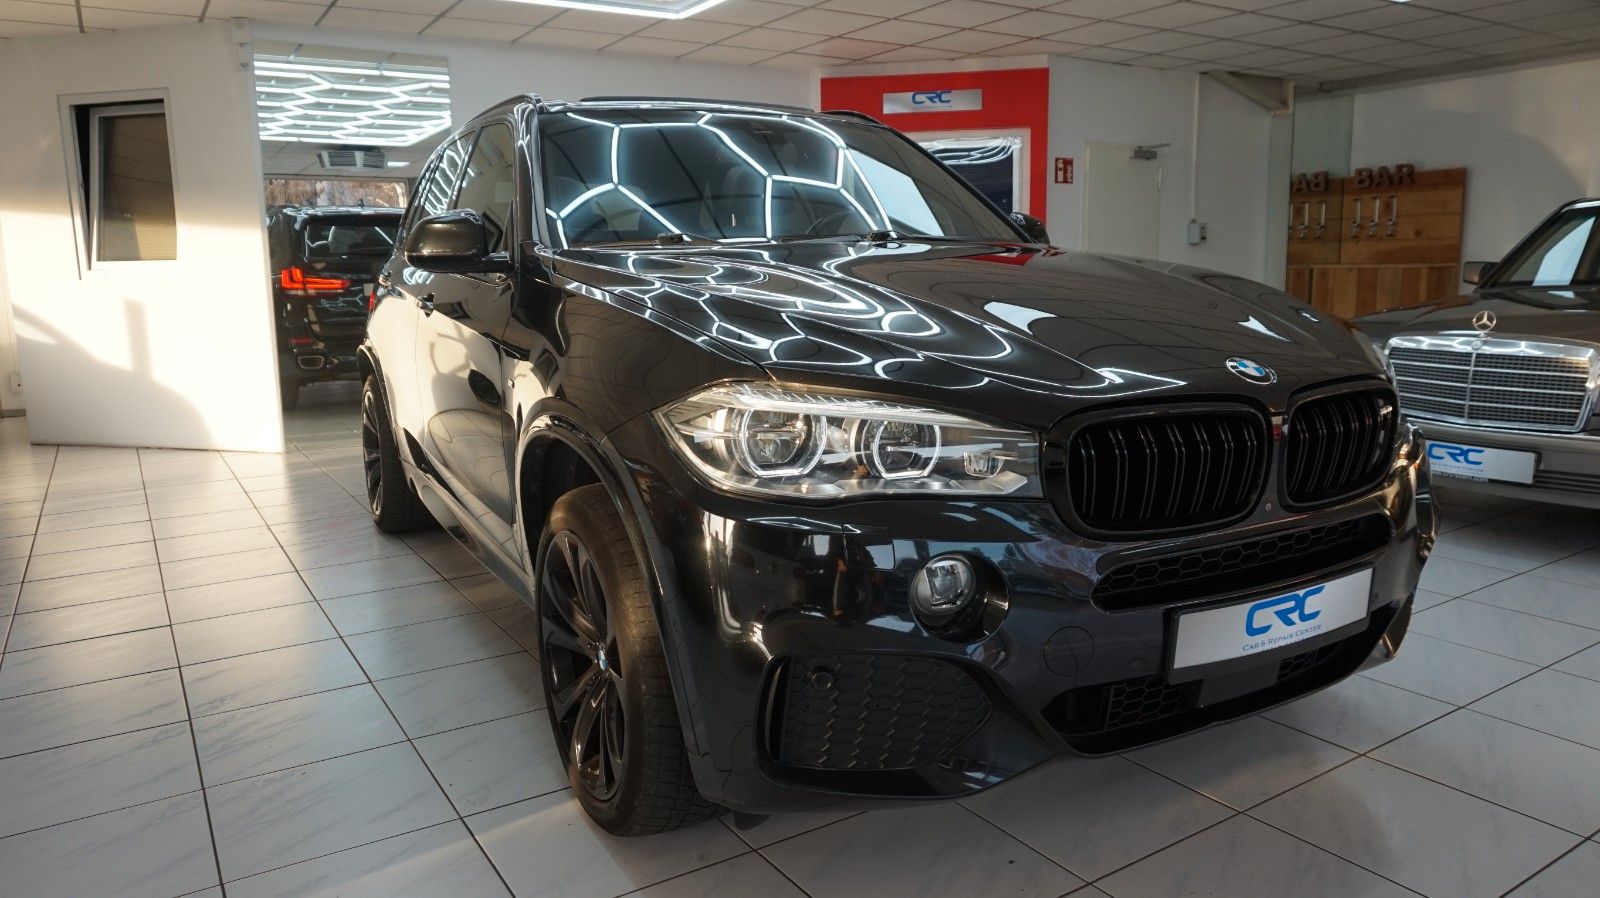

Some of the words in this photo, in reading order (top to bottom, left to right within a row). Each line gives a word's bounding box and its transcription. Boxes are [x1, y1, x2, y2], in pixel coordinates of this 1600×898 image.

[912, 91, 952, 104] CRC
[1354, 163, 1415, 189] BAR
[1428, 443, 1485, 465] CRC
[1245, 585, 1326, 636] CRC
